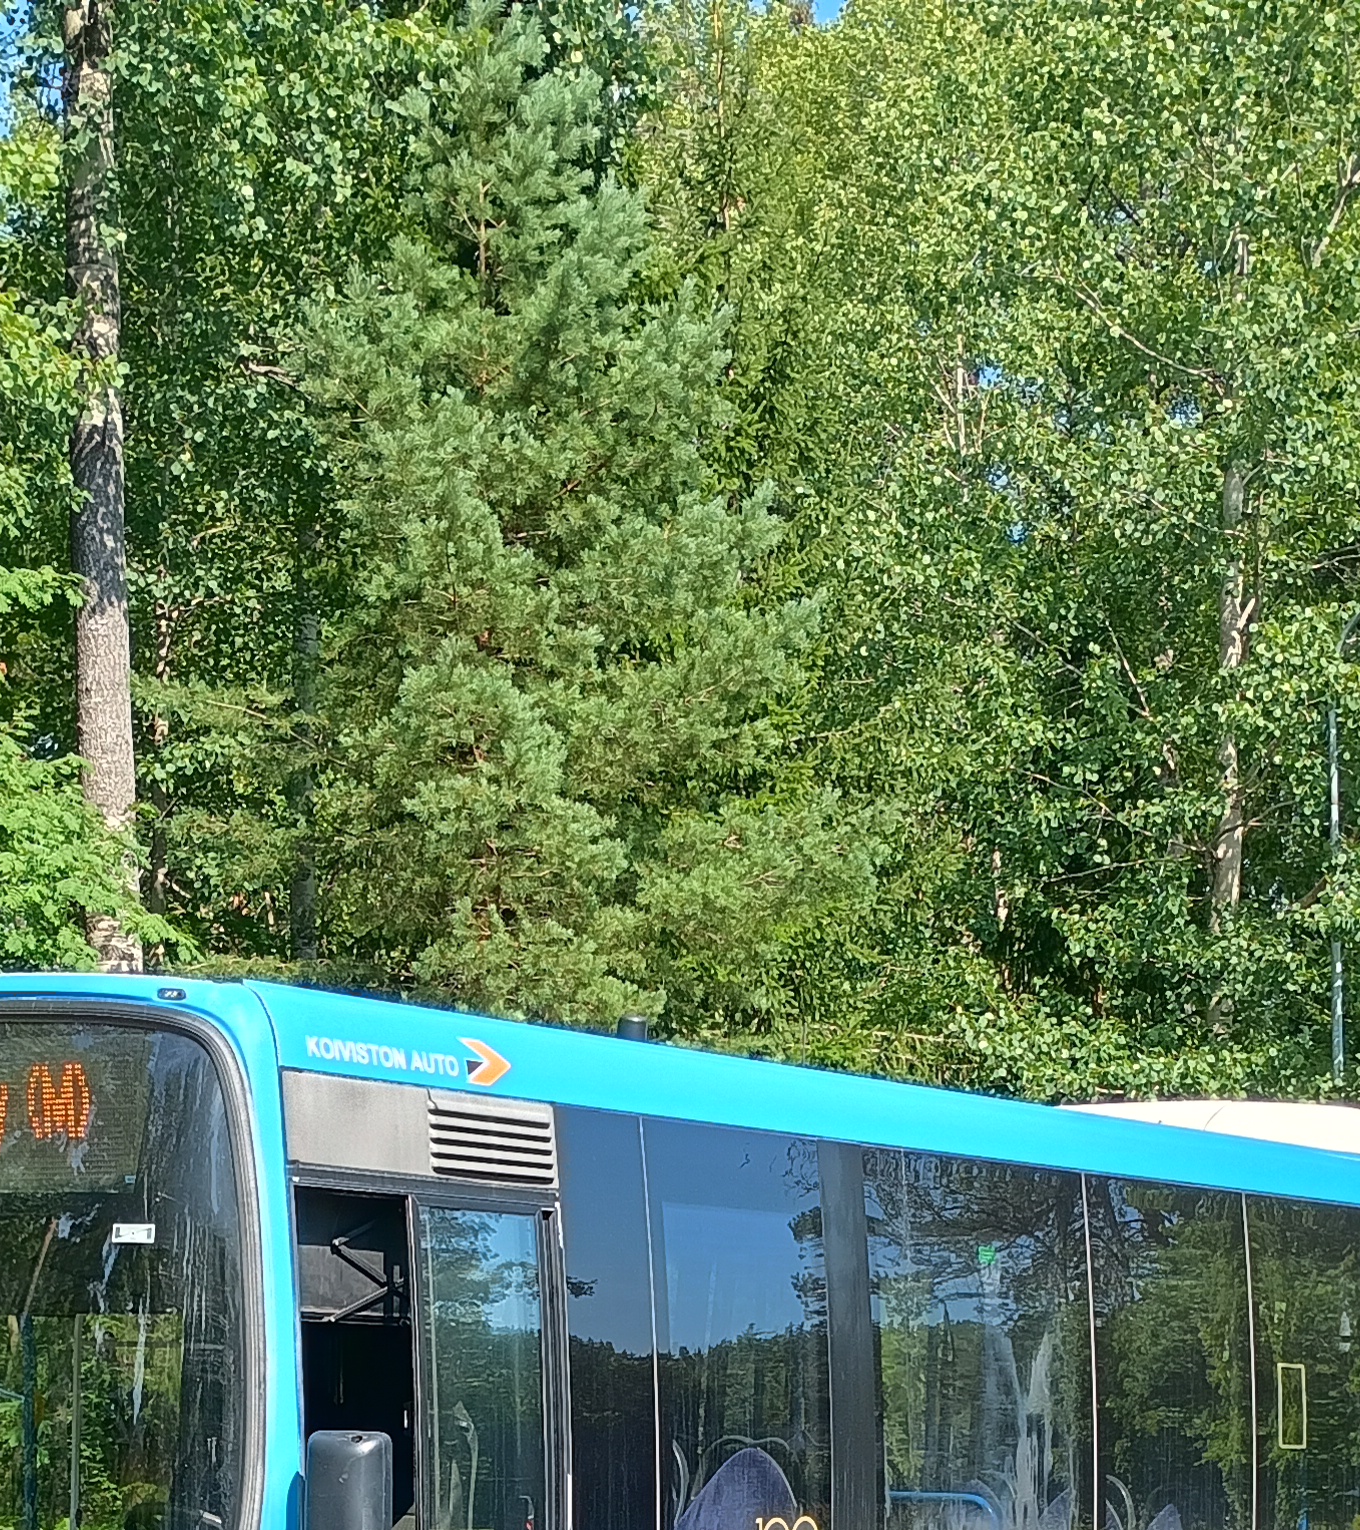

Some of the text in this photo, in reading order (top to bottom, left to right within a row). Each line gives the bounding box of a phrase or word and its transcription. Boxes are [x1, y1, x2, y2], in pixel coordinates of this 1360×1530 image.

[305, 1035, 460, 1077] KOIVISTON AUTO
[27, 1061, 89, 1140] (M)
